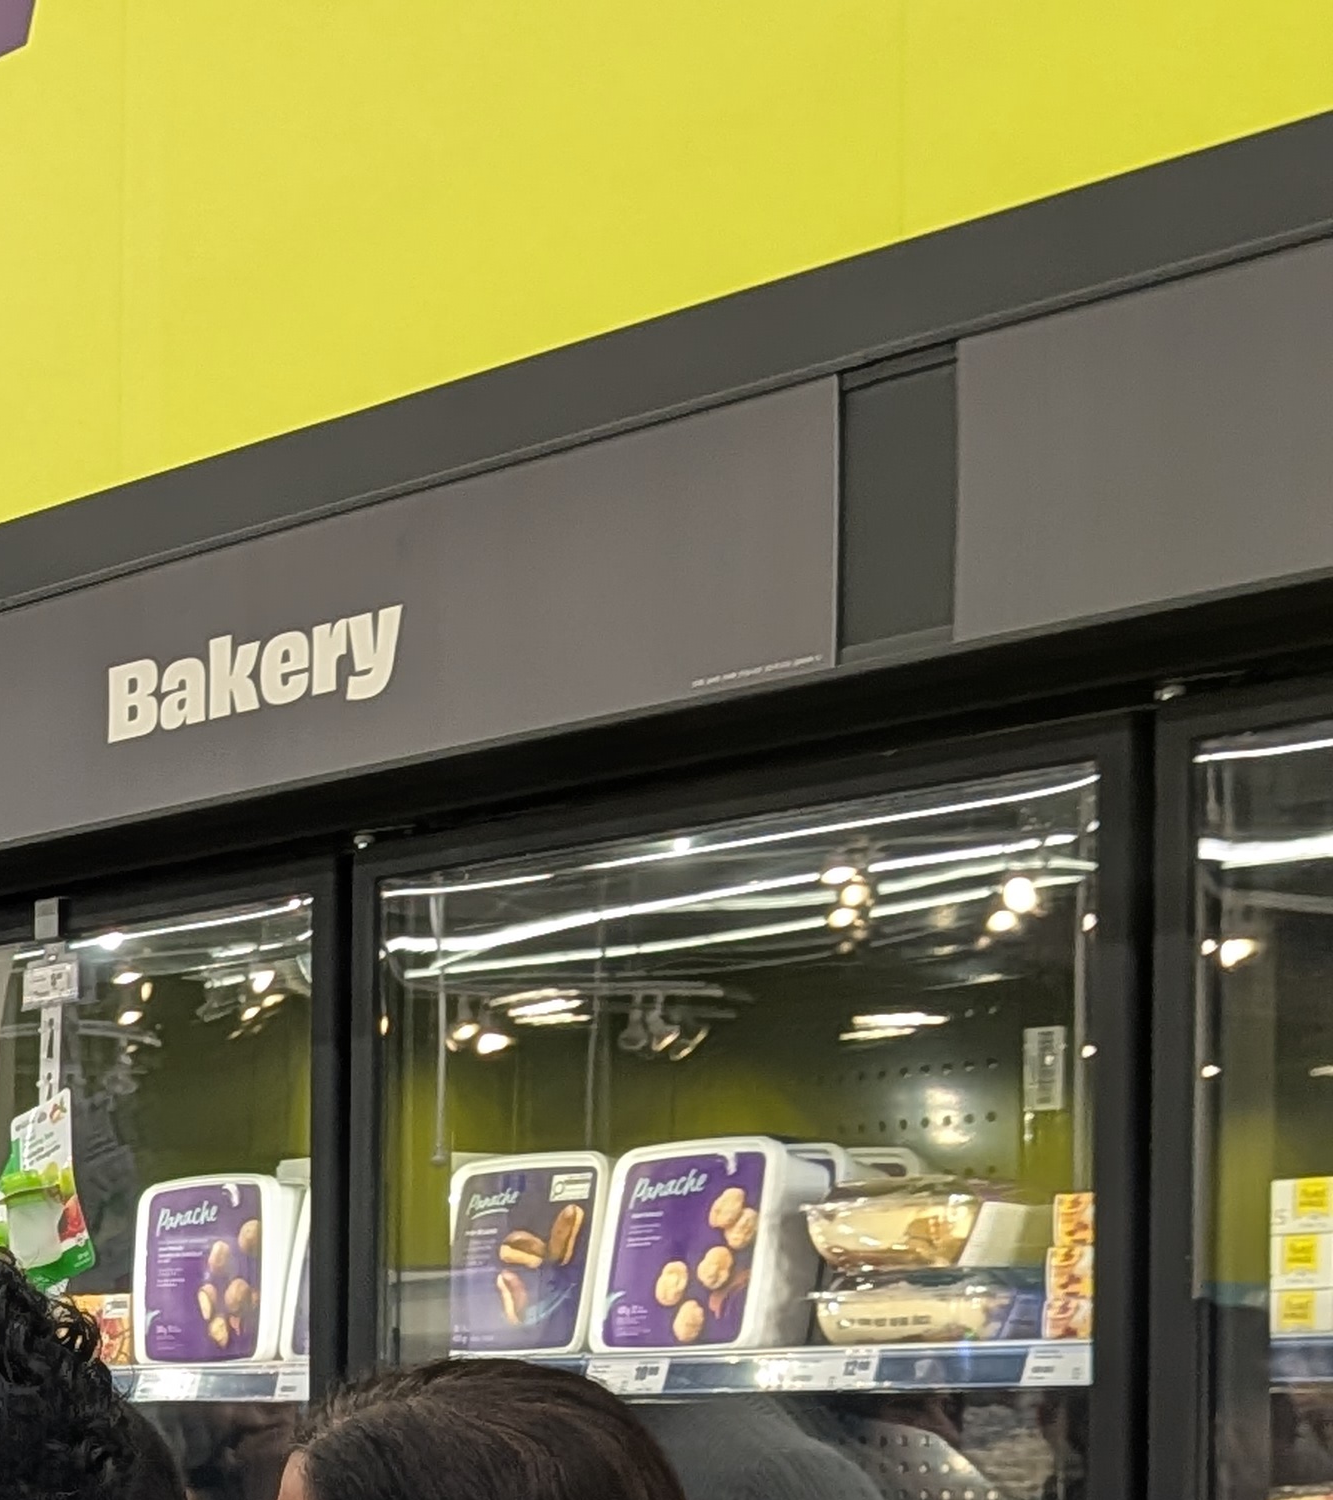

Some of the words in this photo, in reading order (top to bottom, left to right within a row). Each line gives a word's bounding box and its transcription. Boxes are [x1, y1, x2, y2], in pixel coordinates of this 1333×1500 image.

[108, 604, 403, 743] Bakery
[465, 1188, 520, 1216] Panache
[629, 1169, 708, 1209] Panache
[156, 1200, 218, 1237] Panache
